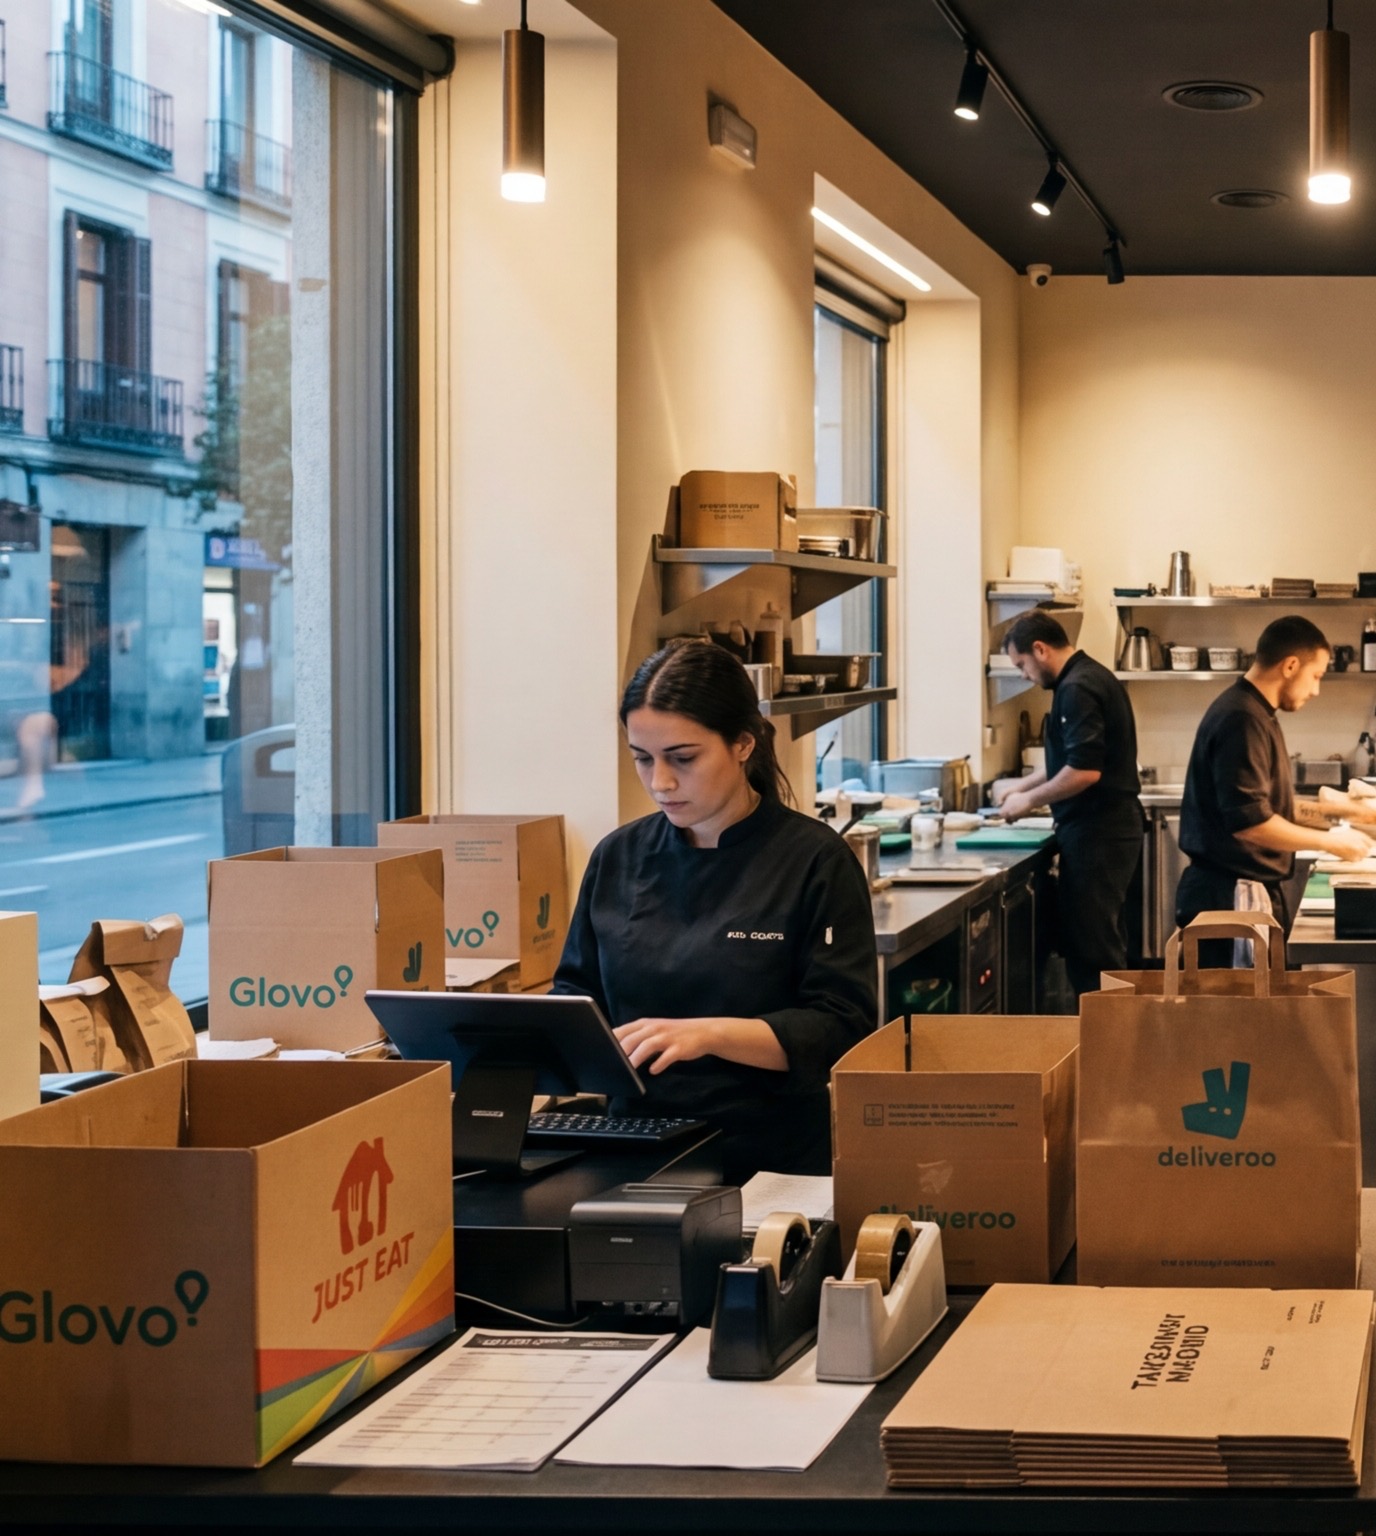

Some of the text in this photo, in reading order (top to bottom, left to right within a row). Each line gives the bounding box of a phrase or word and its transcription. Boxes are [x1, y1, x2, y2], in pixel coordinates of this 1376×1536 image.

[1157, 1145, 1277, 1168] deliveroo
[311, 1230, 415, 1325] JUST EAT
